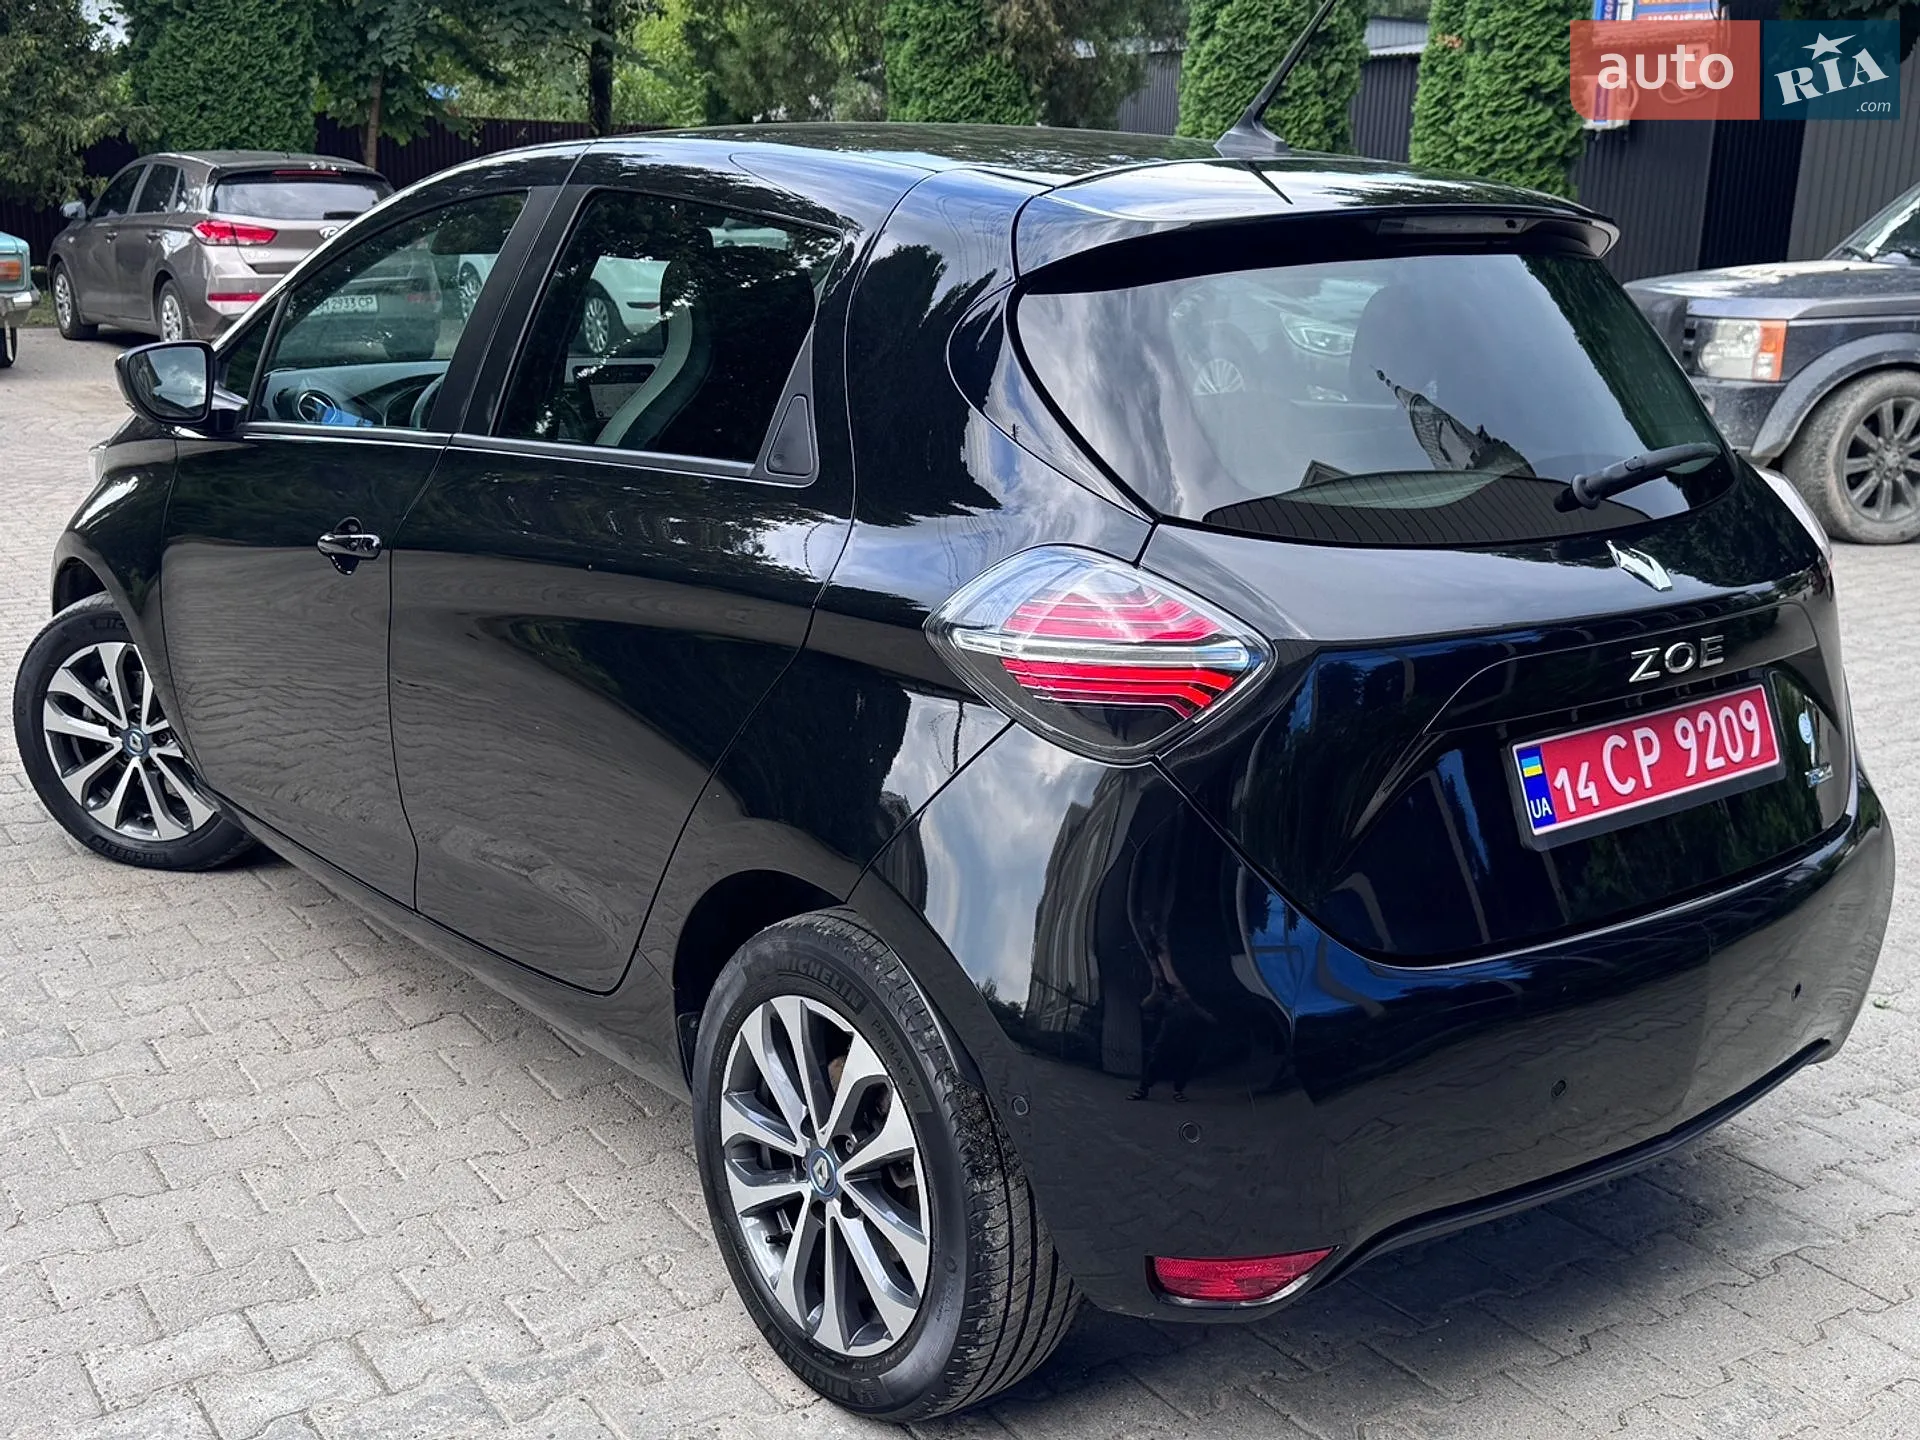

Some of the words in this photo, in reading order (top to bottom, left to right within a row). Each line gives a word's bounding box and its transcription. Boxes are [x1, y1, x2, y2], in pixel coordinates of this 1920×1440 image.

[1628, 635, 1725, 682] ZOE
[1553, 761, 1600, 813] 14
[1602, 726, 1661, 795] CP
[1674, 700, 1762, 777] 9209
[1530, 797, 1552, 818] UA
[778, 950, 866, 1009] MICHELIN
[871, 1020, 917, 1088] PRIMACY
